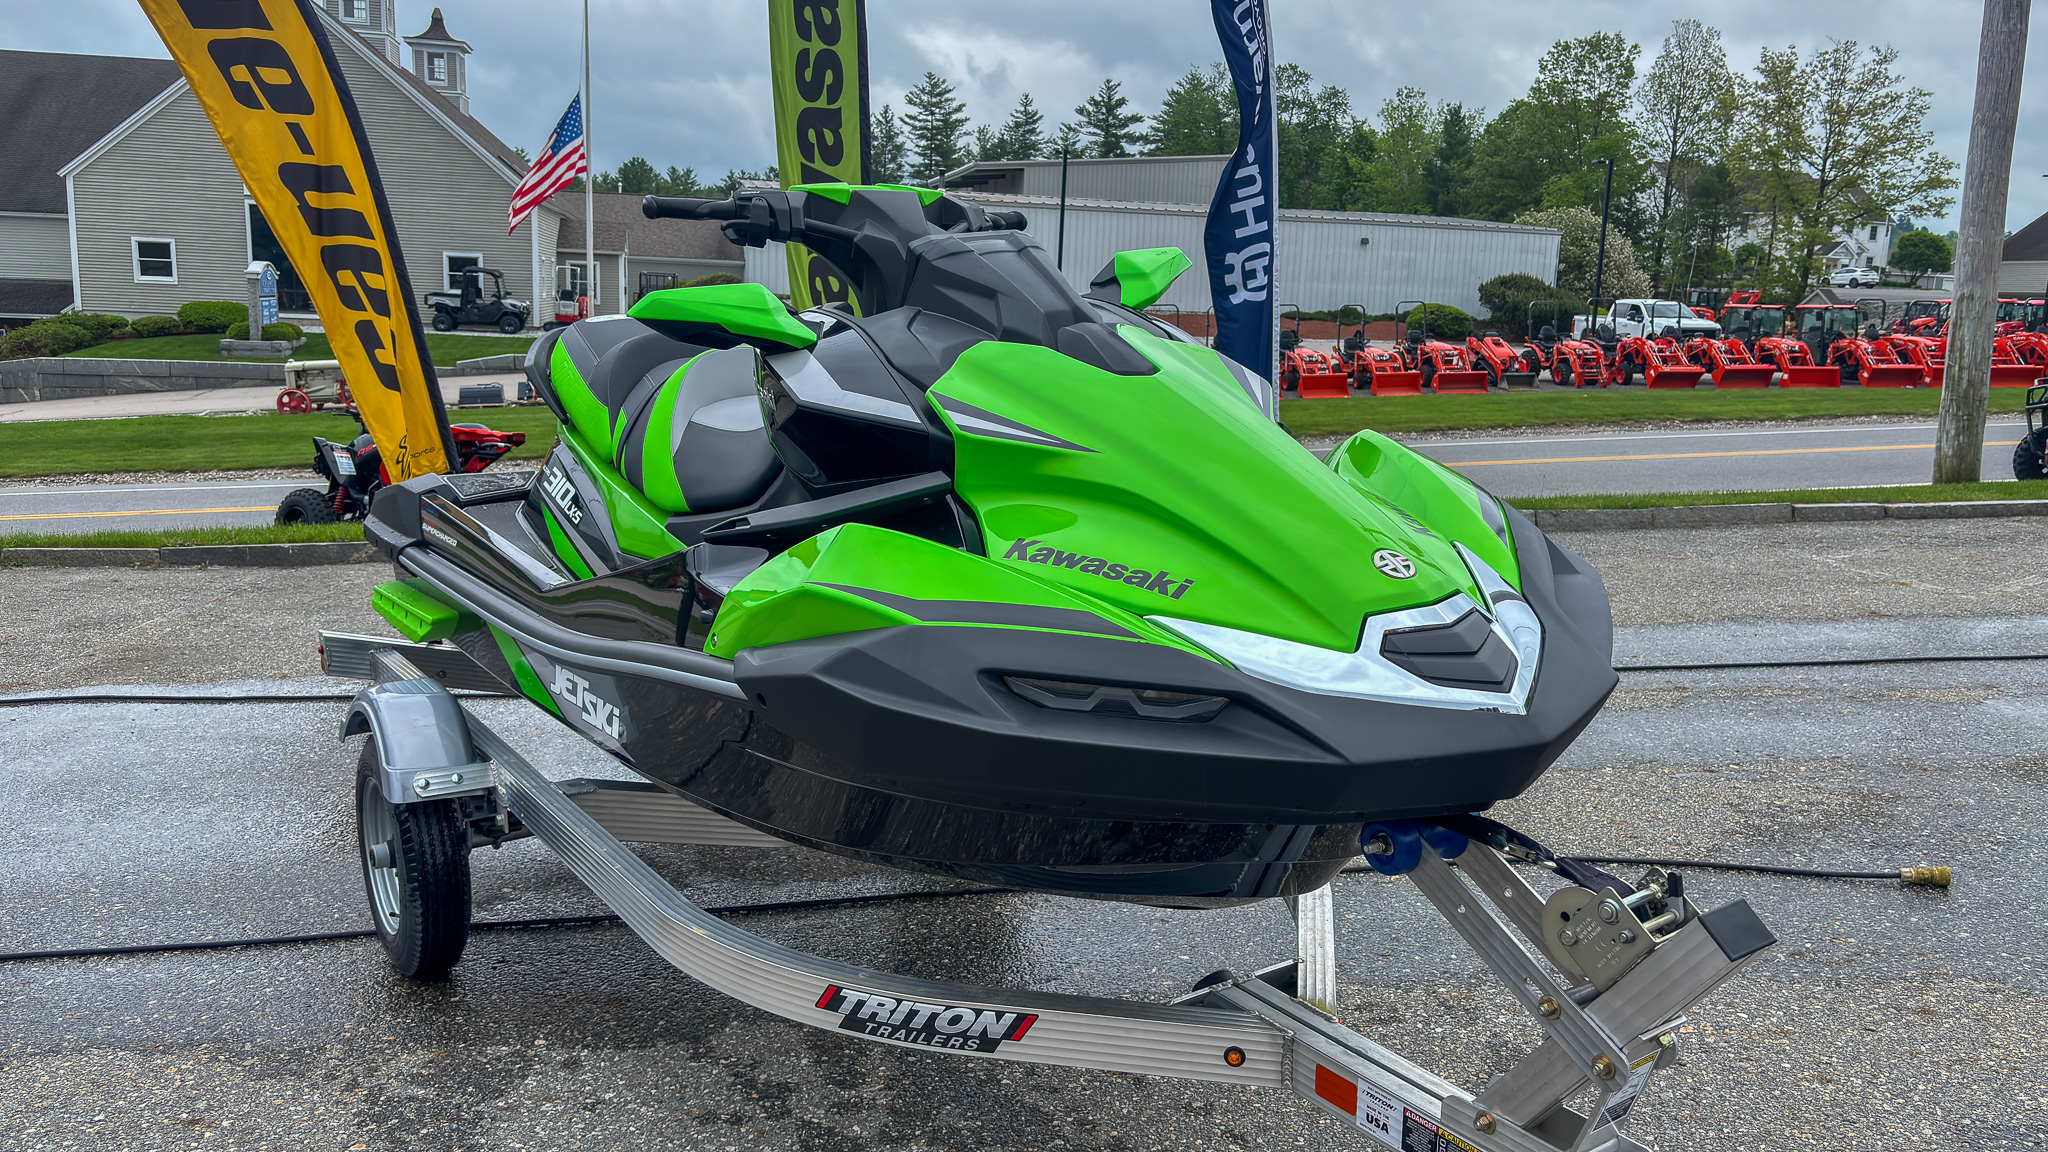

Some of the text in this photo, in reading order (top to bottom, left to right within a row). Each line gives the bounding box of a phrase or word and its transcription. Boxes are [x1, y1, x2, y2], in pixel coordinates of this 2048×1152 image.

[175, 0, 401, 393] can-a
[543, 466, 576, 509] 310
[1002, 537, 1196, 600] Kawasaki
[550, 664, 590, 709] JET
[838, 988, 1018, 1039] TRITON
[864, 1022, 981, 1050] TRAILERS
[1365, 1091, 1394, 1110] TRITON
[1366, 1104, 1377, 1113] MADE
[1366, 1112, 1390, 1135] USA
[1411, 1113, 1437, 1133] DANGER
